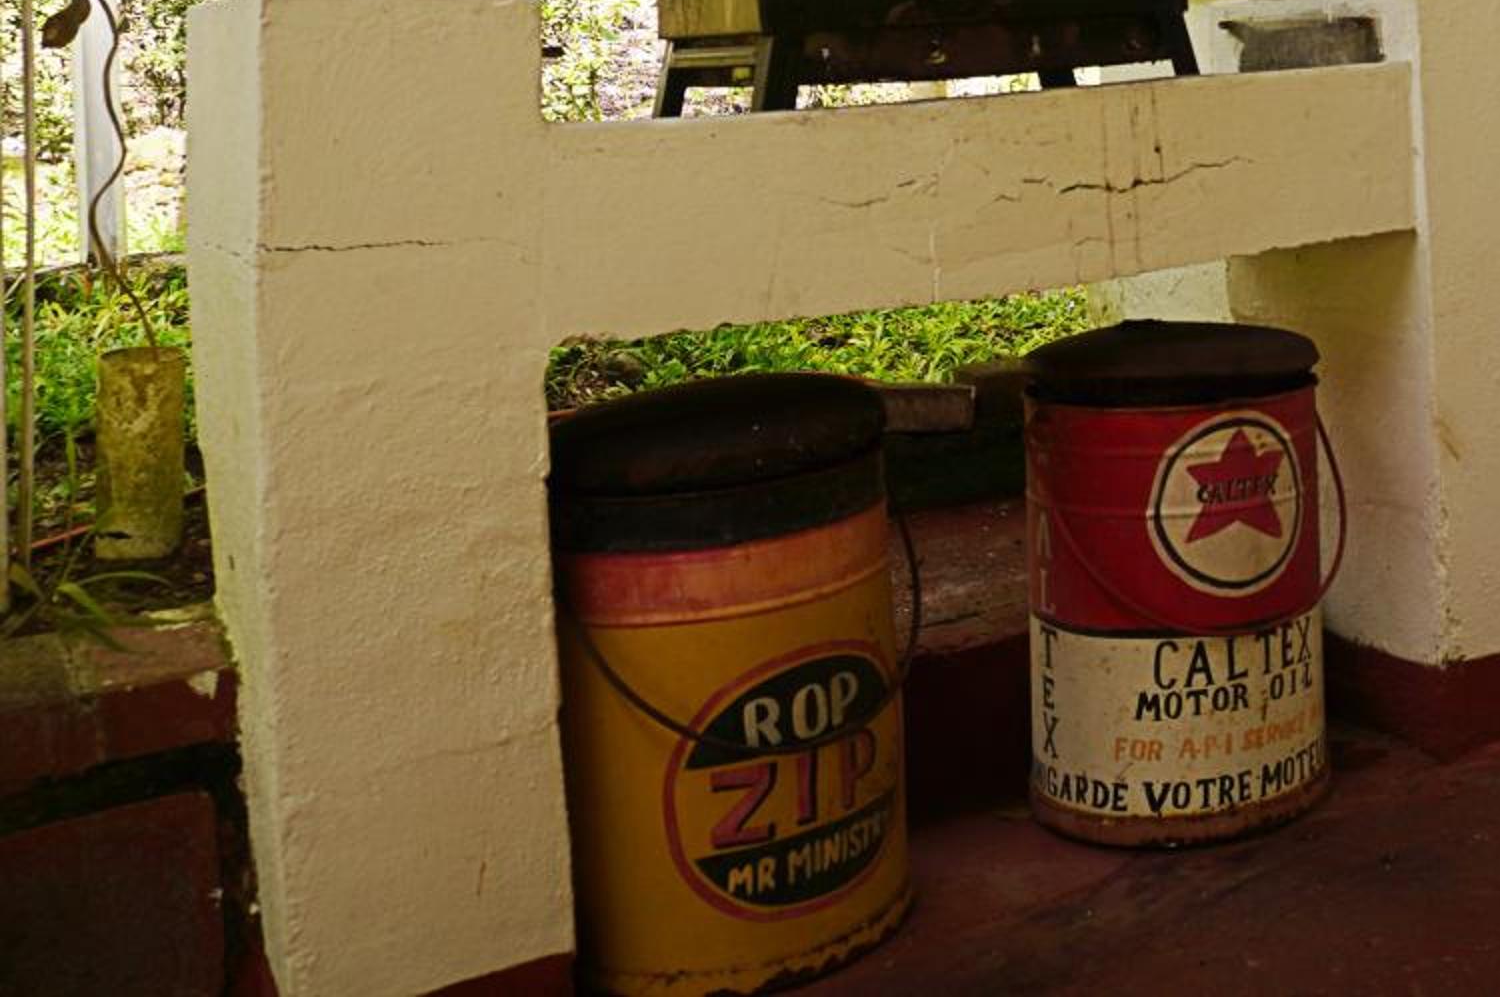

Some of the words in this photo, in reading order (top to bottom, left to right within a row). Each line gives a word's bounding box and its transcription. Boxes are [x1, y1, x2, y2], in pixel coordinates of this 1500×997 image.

[1153, 615, 1312, 690] CALTEX
[742, 670, 860, 749] ROP
[1135, 683, 1250, 722] MOTOR
[1270, 662, 1313, 700] OIL
[1114, 736, 1163, 763] FOR
[709, 729, 876, 849] ZIP
[1143, 774, 1251, 814] VOTRE
[727, 855, 777, 896] MR
